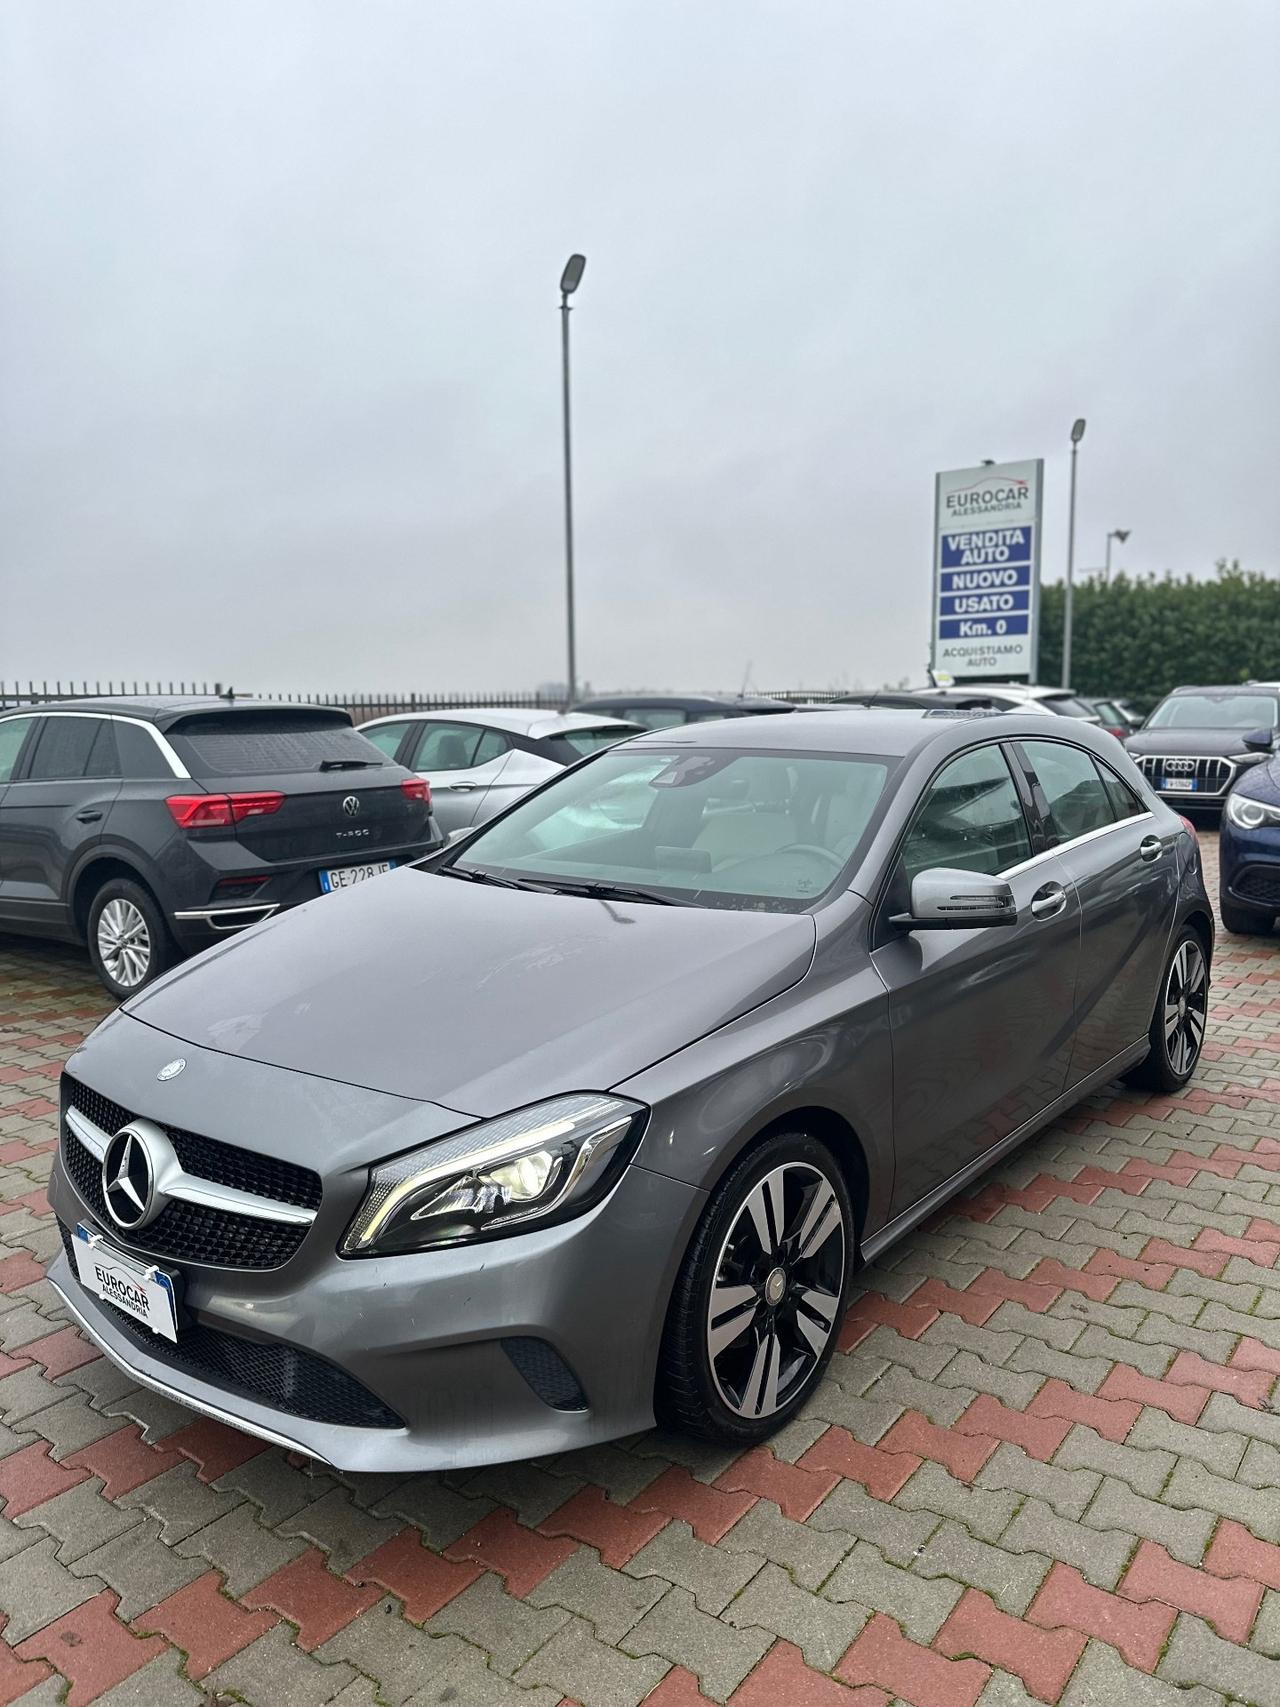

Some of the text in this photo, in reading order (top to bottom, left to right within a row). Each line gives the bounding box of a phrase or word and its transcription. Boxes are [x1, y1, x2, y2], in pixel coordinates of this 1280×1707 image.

[946, 486, 1029, 508] EUROCAR
[952, 502, 1022, 517] ALESSANDRIA
[947, 529, 1024, 551] VENDITA
[960, 546, 1009, 565] AUTO
[952, 569, 1018, 590] NUOVO
[954, 594, 1014, 613] USATO
[959, 619, 1007, 637] Km. 0
[942, 644, 1023, 658] ACQUISTIAMO
[966, 656, 997, 667] AUTO
[94, 1265, 150, 1311] EUROCAR
[102, 1283, 149, 1318] ALESSANDRIA
